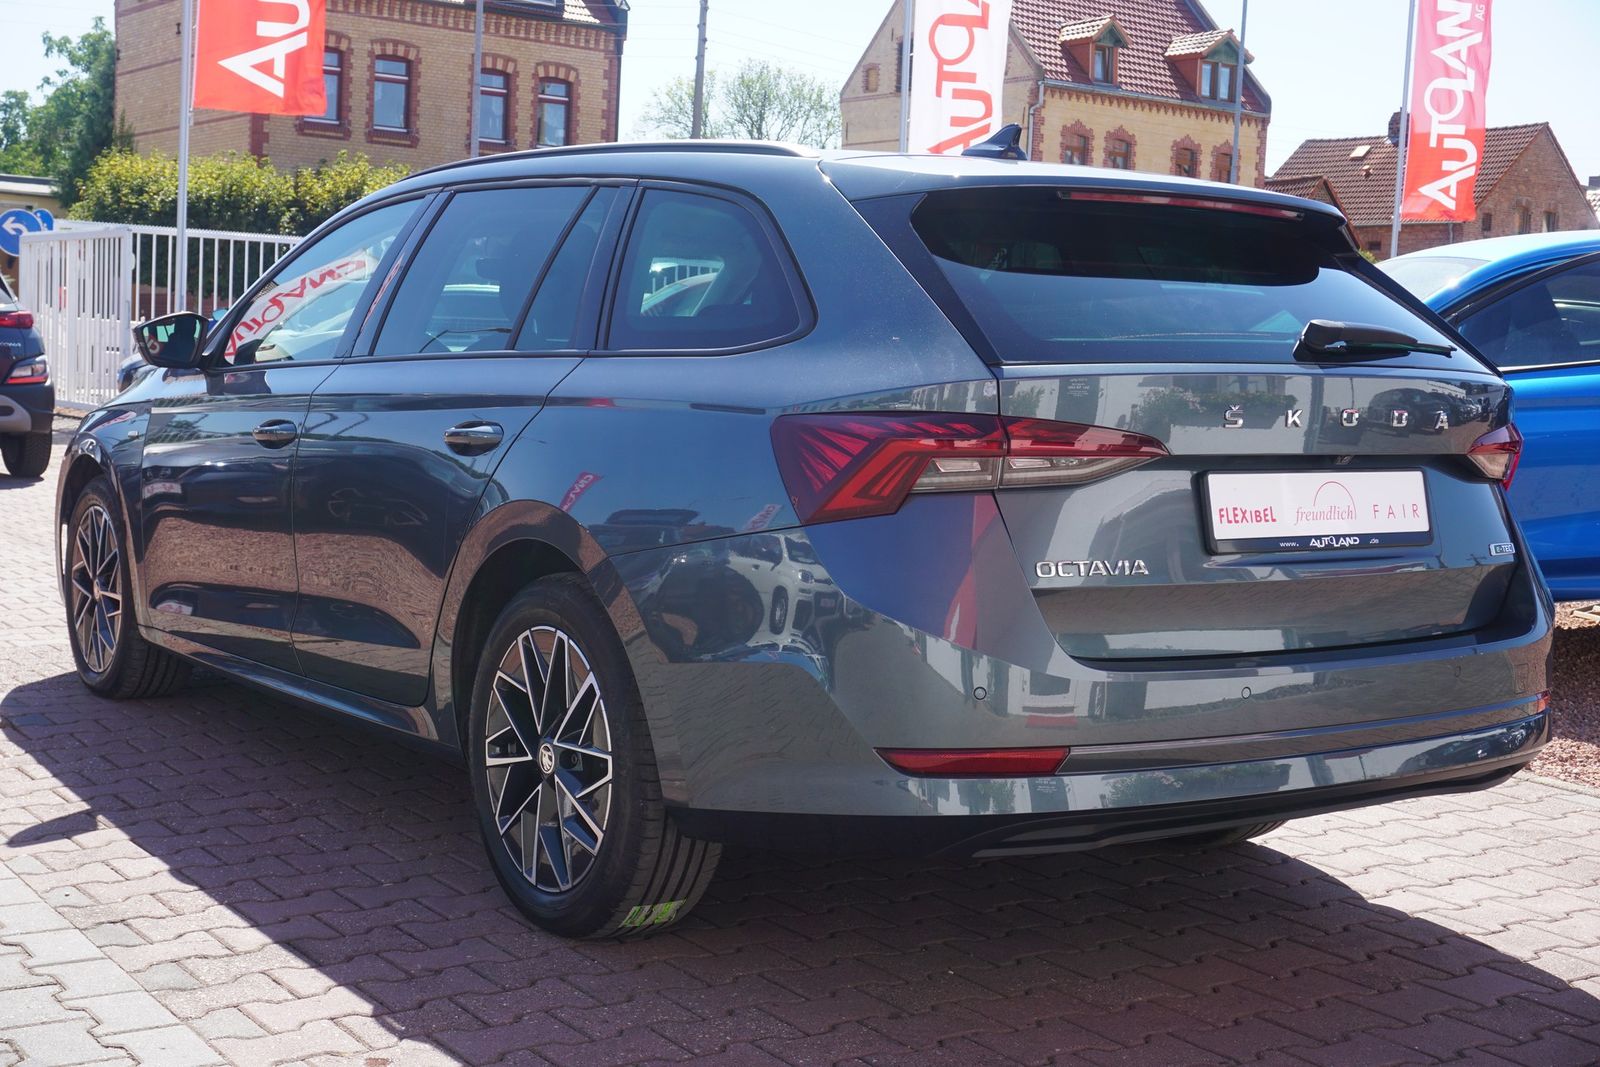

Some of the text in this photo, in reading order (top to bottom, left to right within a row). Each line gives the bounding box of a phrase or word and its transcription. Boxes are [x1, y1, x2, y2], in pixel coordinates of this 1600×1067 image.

[1474, 4, 1486, 21] AG
[1223, 405, 1449, 430] ŠKODA
[1218, 503, 1420, 525] FLEXIBEL freundlich FAIR
[1309, 535, 1360, 548] AUTOLAND
[1035, 559, 1150, 578] OCTAVIA
